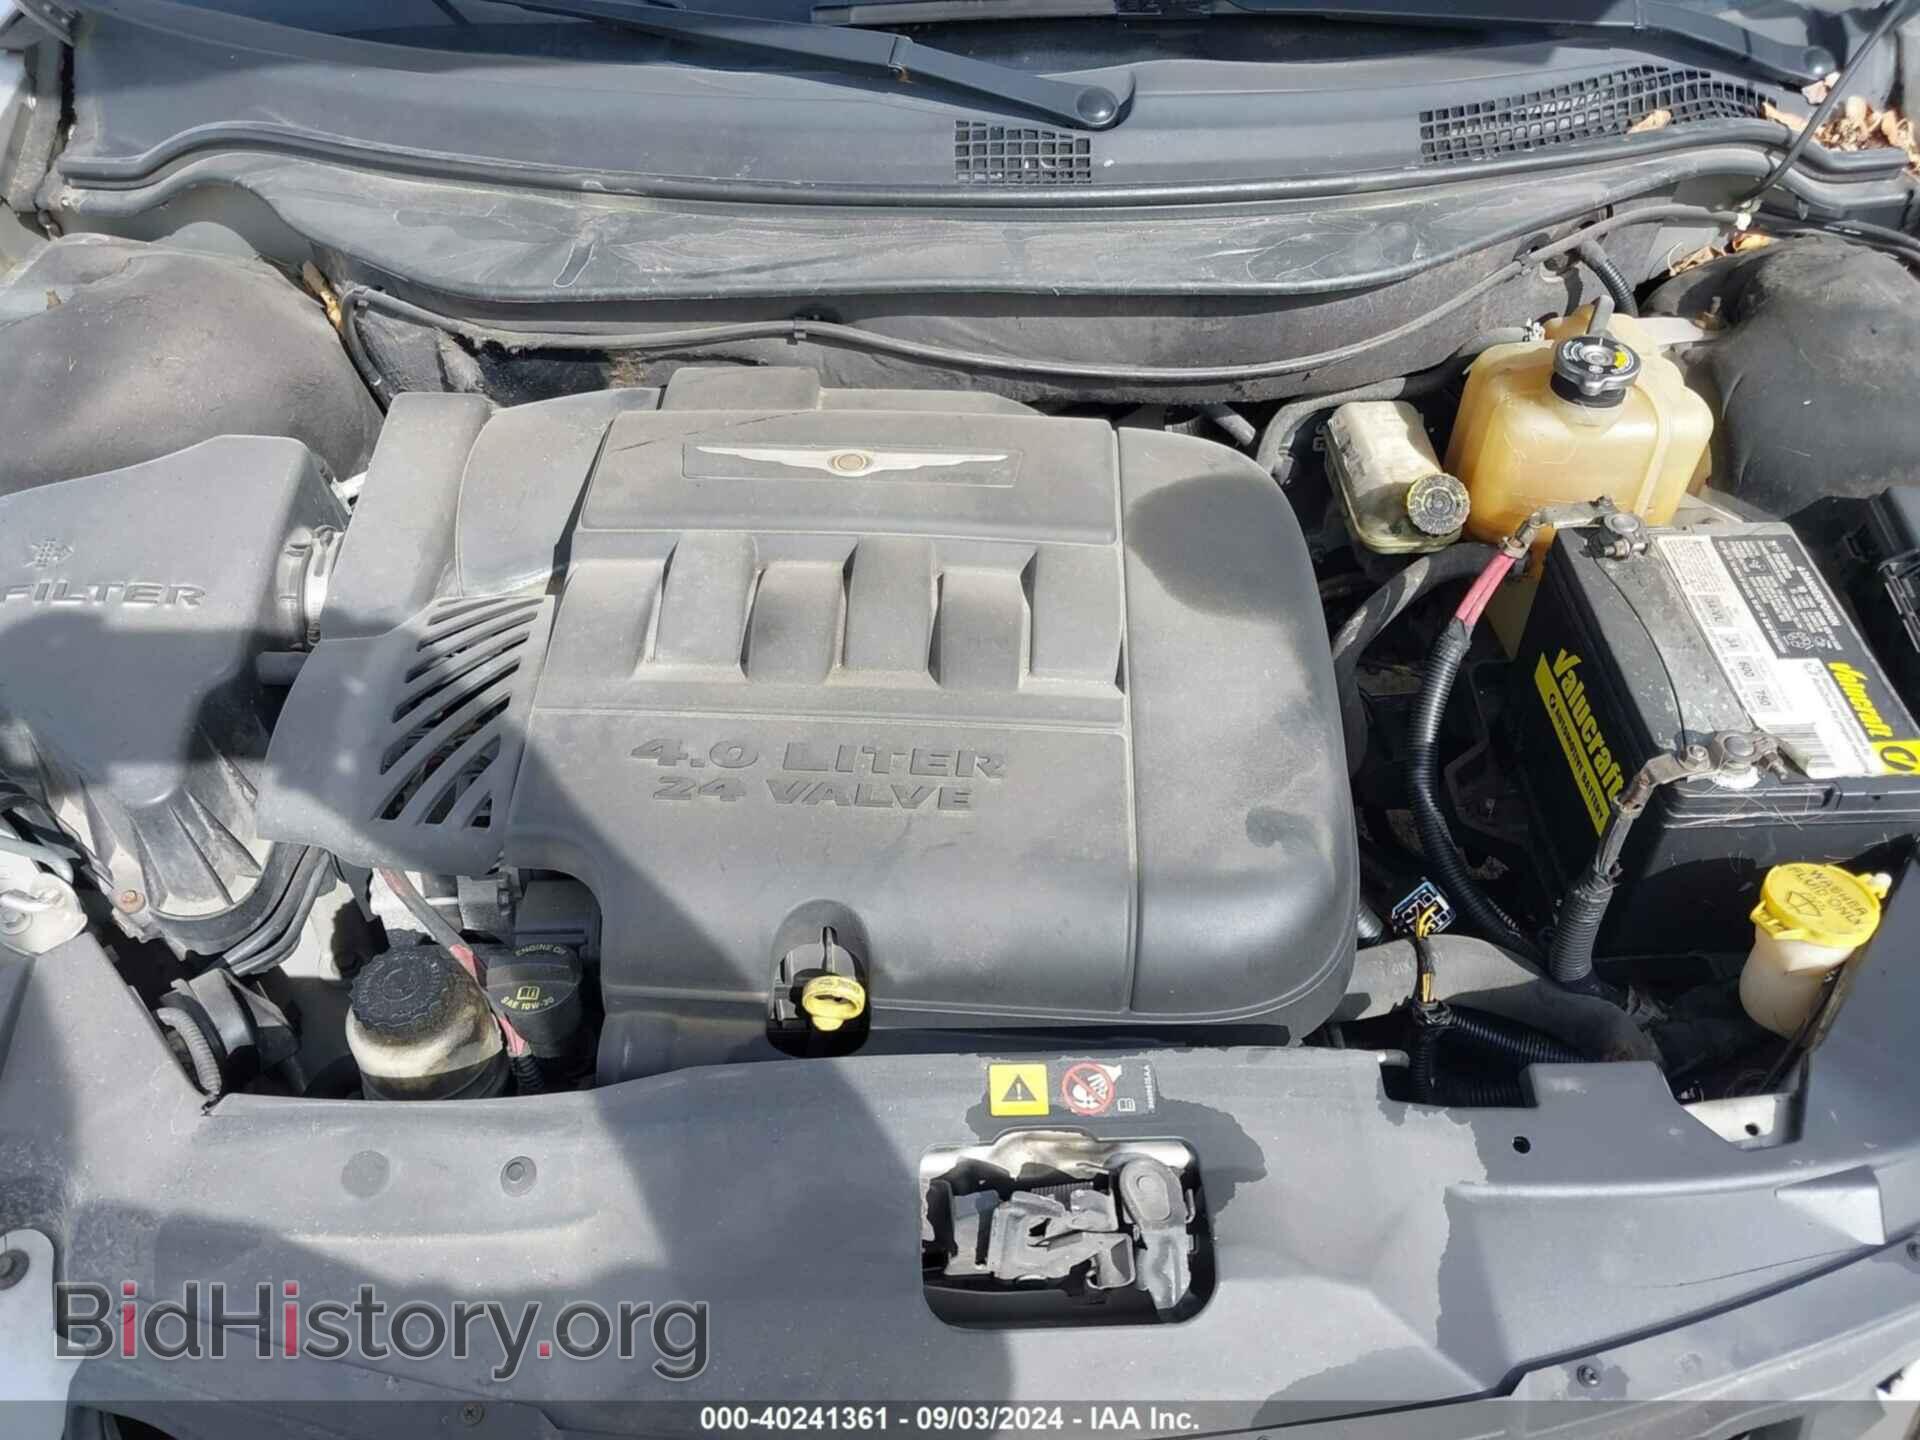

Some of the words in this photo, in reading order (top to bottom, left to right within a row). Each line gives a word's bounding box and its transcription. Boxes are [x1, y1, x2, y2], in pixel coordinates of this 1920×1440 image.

[1, 578, 207, 608] FILTER
[1553, 648, 1625, 802] Valucraft
[630, 738, 759, 770] 4.0
[782, 741, 1006, 779] LITER
[652, 776, 747, 803] 24
[765, 779, 975, 812] VALVE
